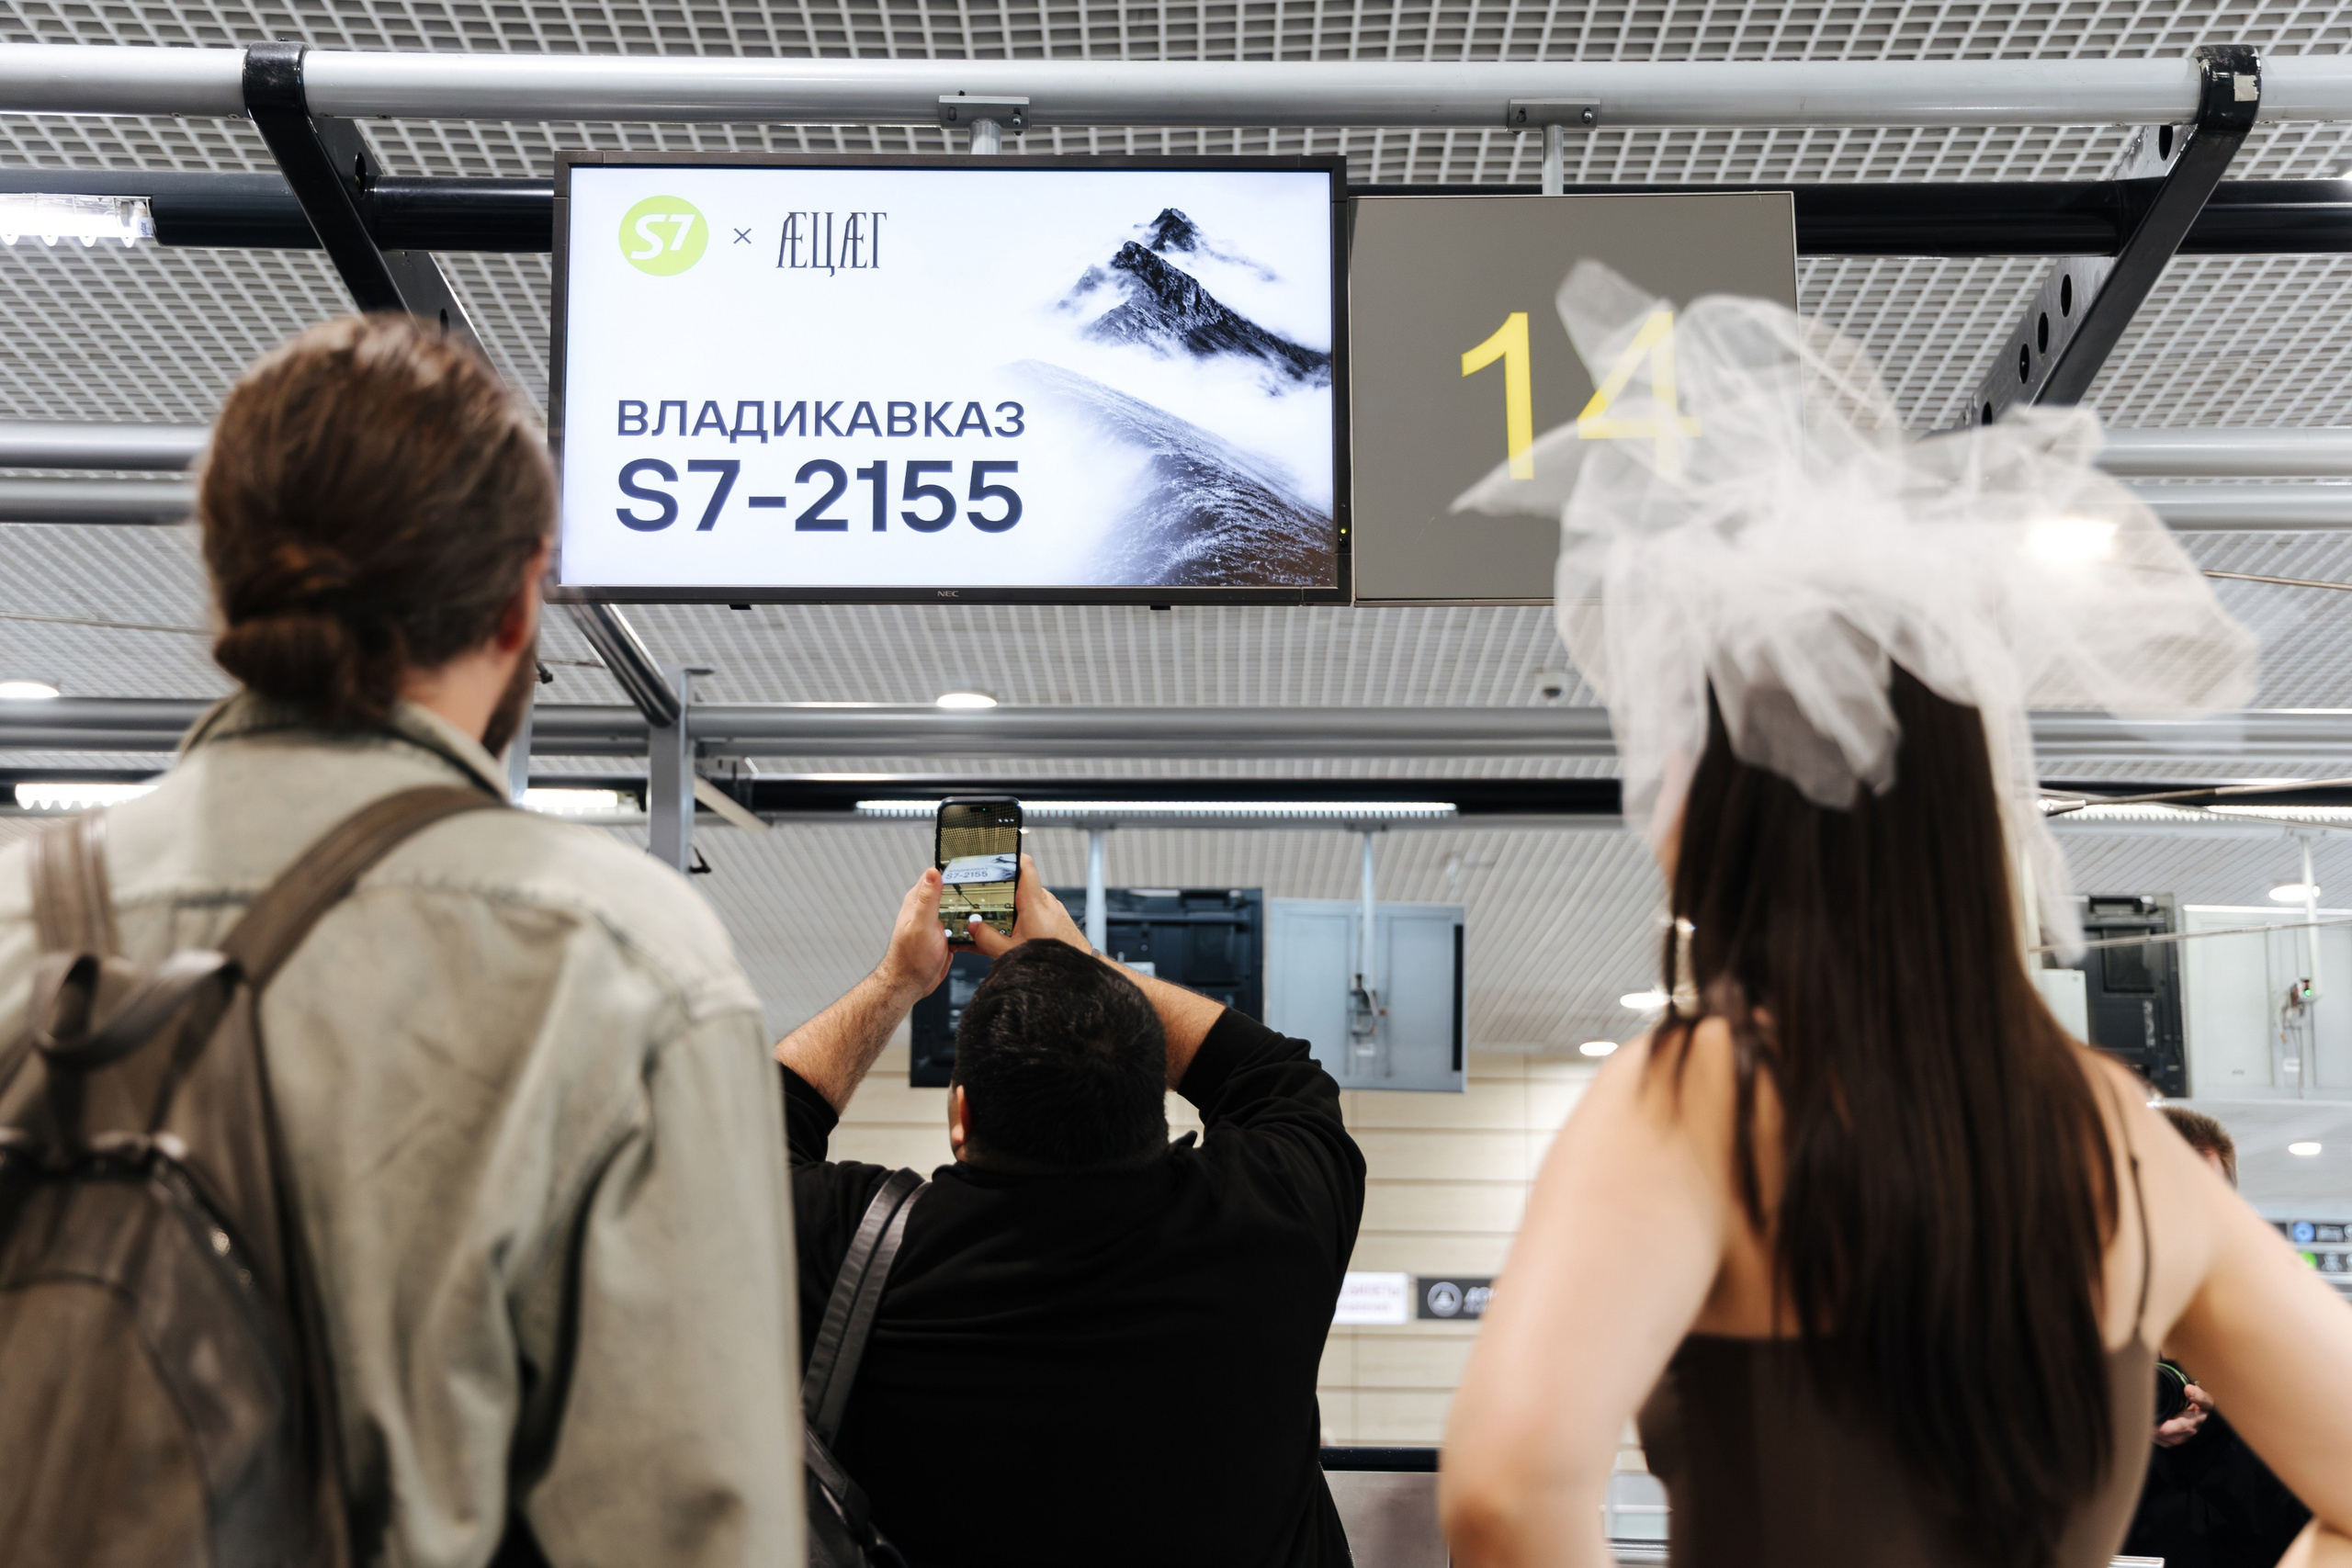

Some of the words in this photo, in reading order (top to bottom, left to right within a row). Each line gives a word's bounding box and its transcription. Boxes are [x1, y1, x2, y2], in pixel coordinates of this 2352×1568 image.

[630, 213, 695, 260] S7
[1462, 311, 1702, 481] 14
[617, 400, 1025, 444] ВЛАДИКАВКАЗ
[616, 457, 1023, 533] S7-2155
[945, 871, 989, 879] S7-2155
